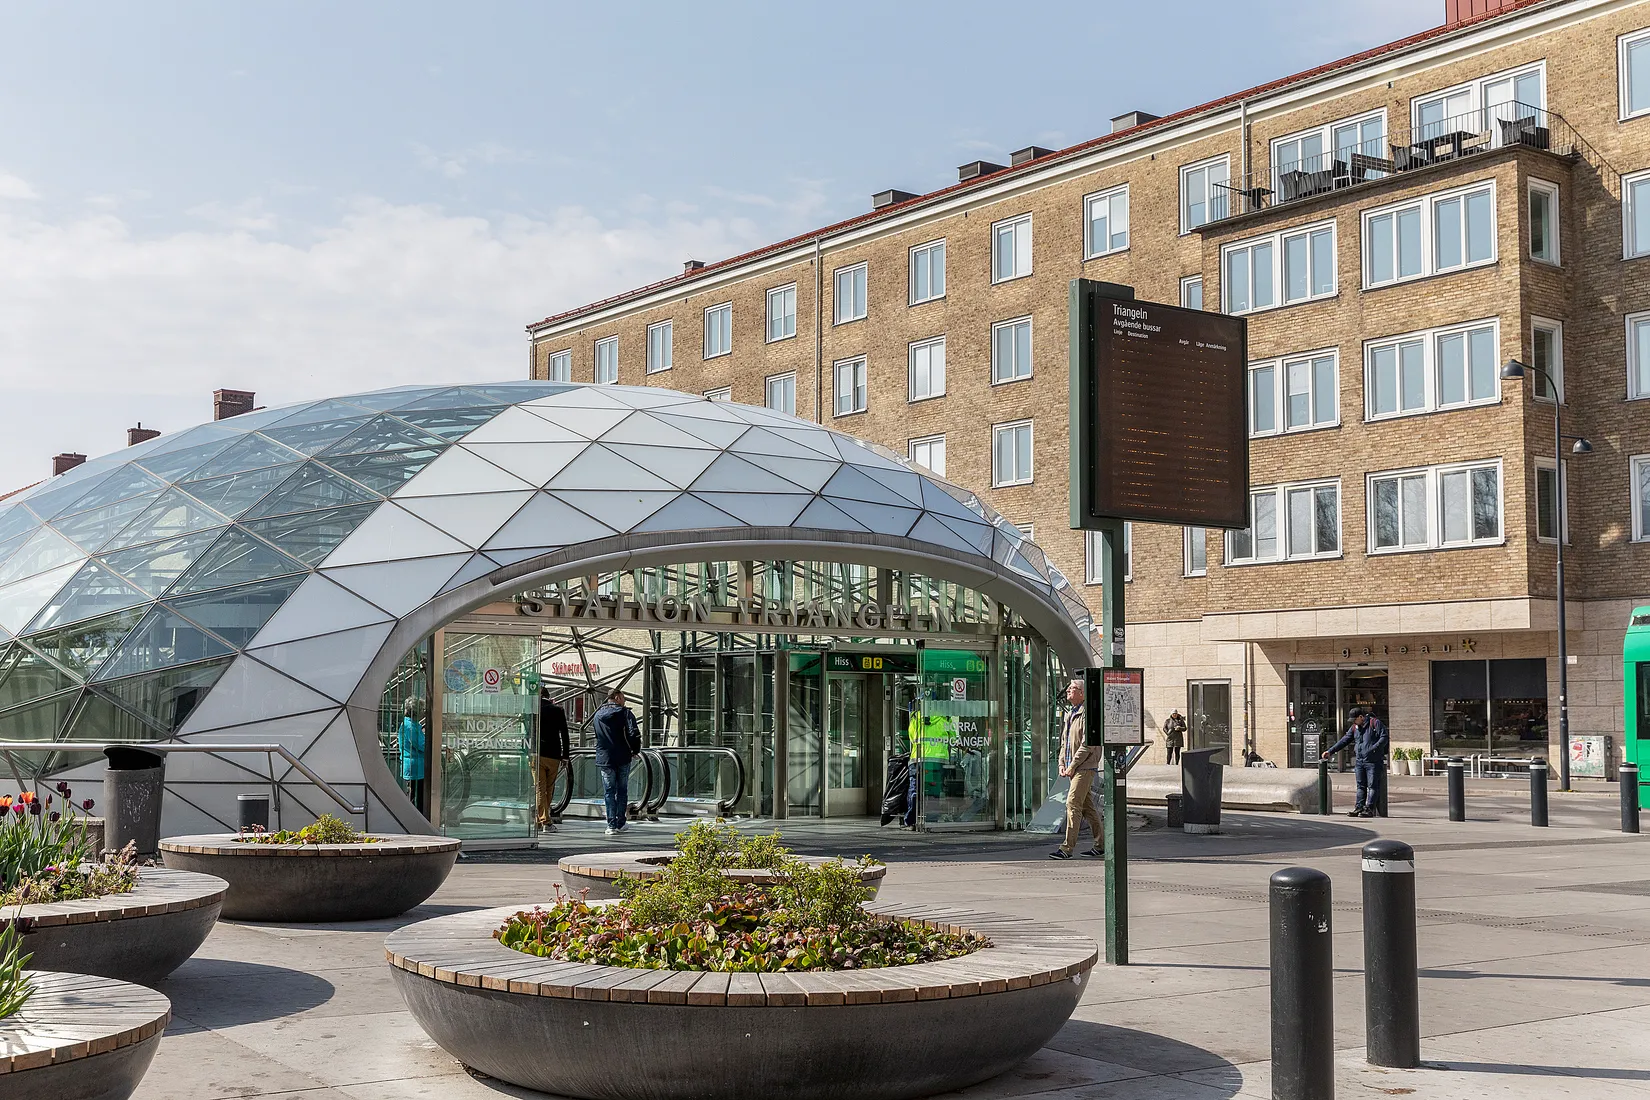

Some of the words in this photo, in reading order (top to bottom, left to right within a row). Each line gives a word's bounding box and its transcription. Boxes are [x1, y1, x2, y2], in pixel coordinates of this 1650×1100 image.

[1113, 304, 1148, 320] Triangeln
[1113, 318, 1142, 330] Avgående
[1142, 323, 1161, 332] bussar
[1113, 328, 1123, 336] Linje
[1127, 331, 1149, 339] Destination
[521, 588, 711, 623] STATION
[737, 597, 951, 632] TRIANGELN
[1341, 644, 1452, 658] gateau
[834, 656, 849, 666] Hiss
[940, 660, 954, 669] Hiss
[944, 721, 978, 732] NORRA
